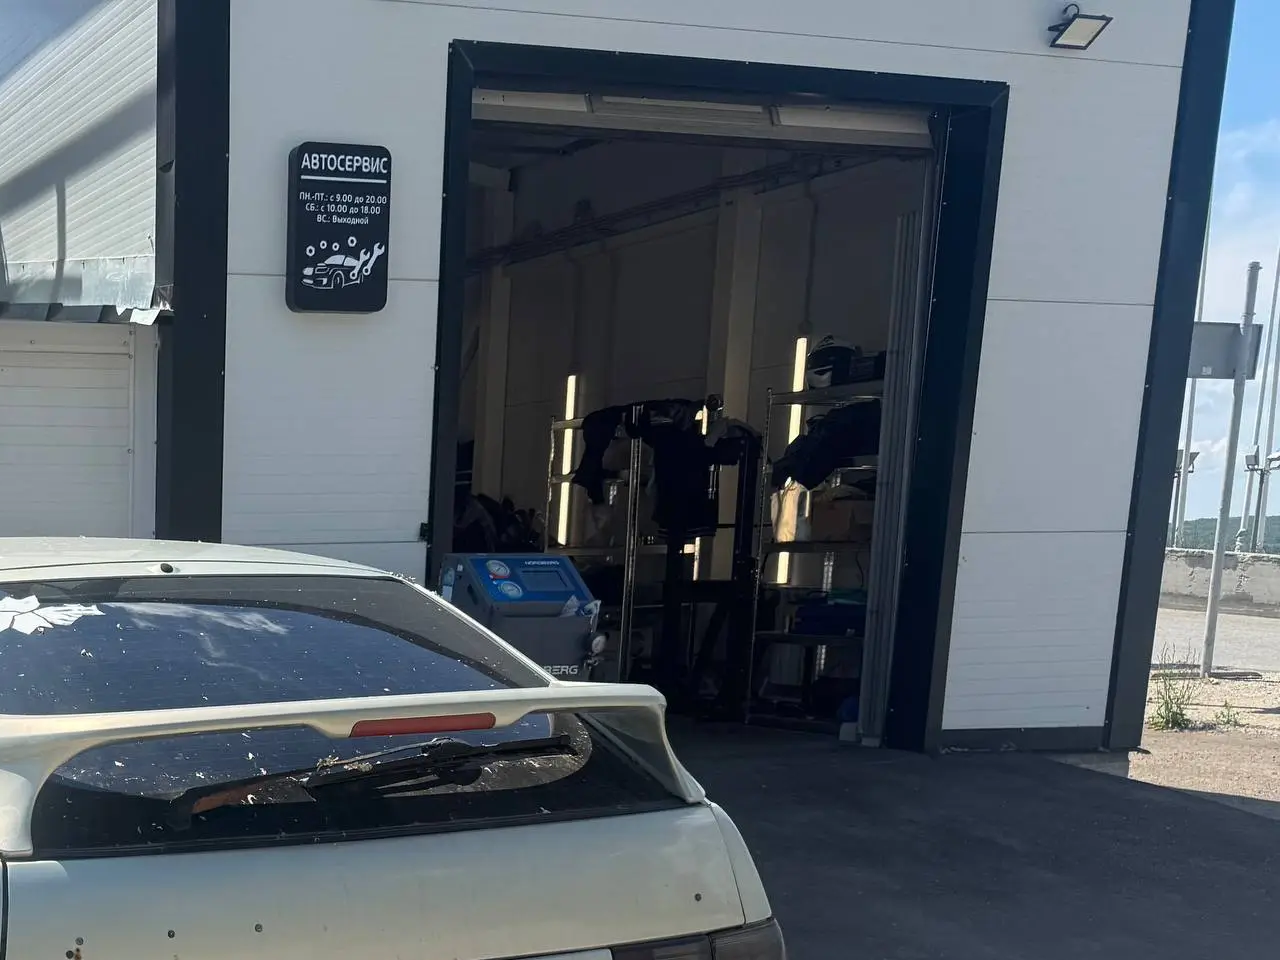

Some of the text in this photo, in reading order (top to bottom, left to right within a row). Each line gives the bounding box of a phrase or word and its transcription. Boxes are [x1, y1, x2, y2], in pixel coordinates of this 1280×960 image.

[301, 152, 388, 174] АВТОСЕРВИС
[336, 193, 353, 203] 9.00
[354, 196, 364, 204] до
[365, 195, 387, 205] 20.00
[327, 203, 348, 213] 10.00
[349, 206, 359, 214] до
[360, 205, 381, 214] 18.00
[332, 215, 369, 225] Выходной
[544, 665, 578, 675] BERG
